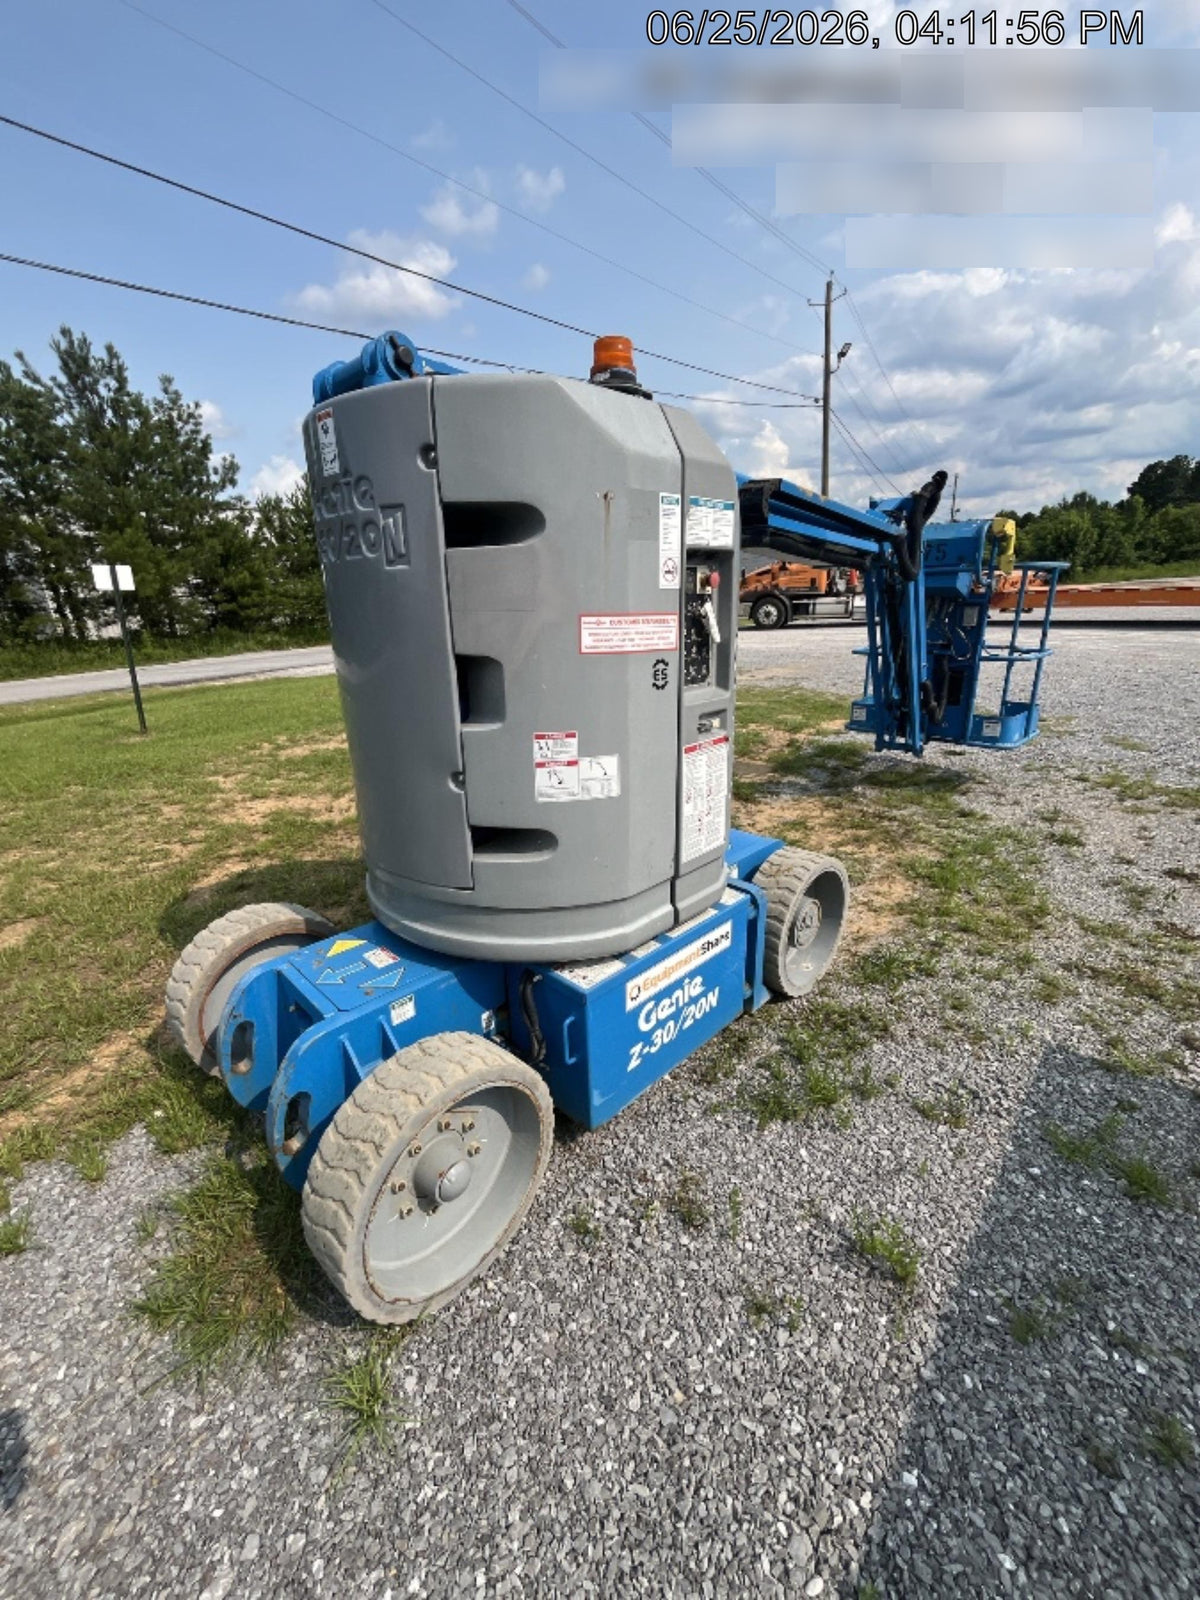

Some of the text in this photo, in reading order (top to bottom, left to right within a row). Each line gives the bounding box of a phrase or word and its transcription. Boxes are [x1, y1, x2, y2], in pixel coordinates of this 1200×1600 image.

[653, 667, 668, 682] ES
[642, 930, 731, 991] EquipmentShare
[627, 986, 720, 1073] Z-30/20N
[637, 975, 706, 1032] Genie
